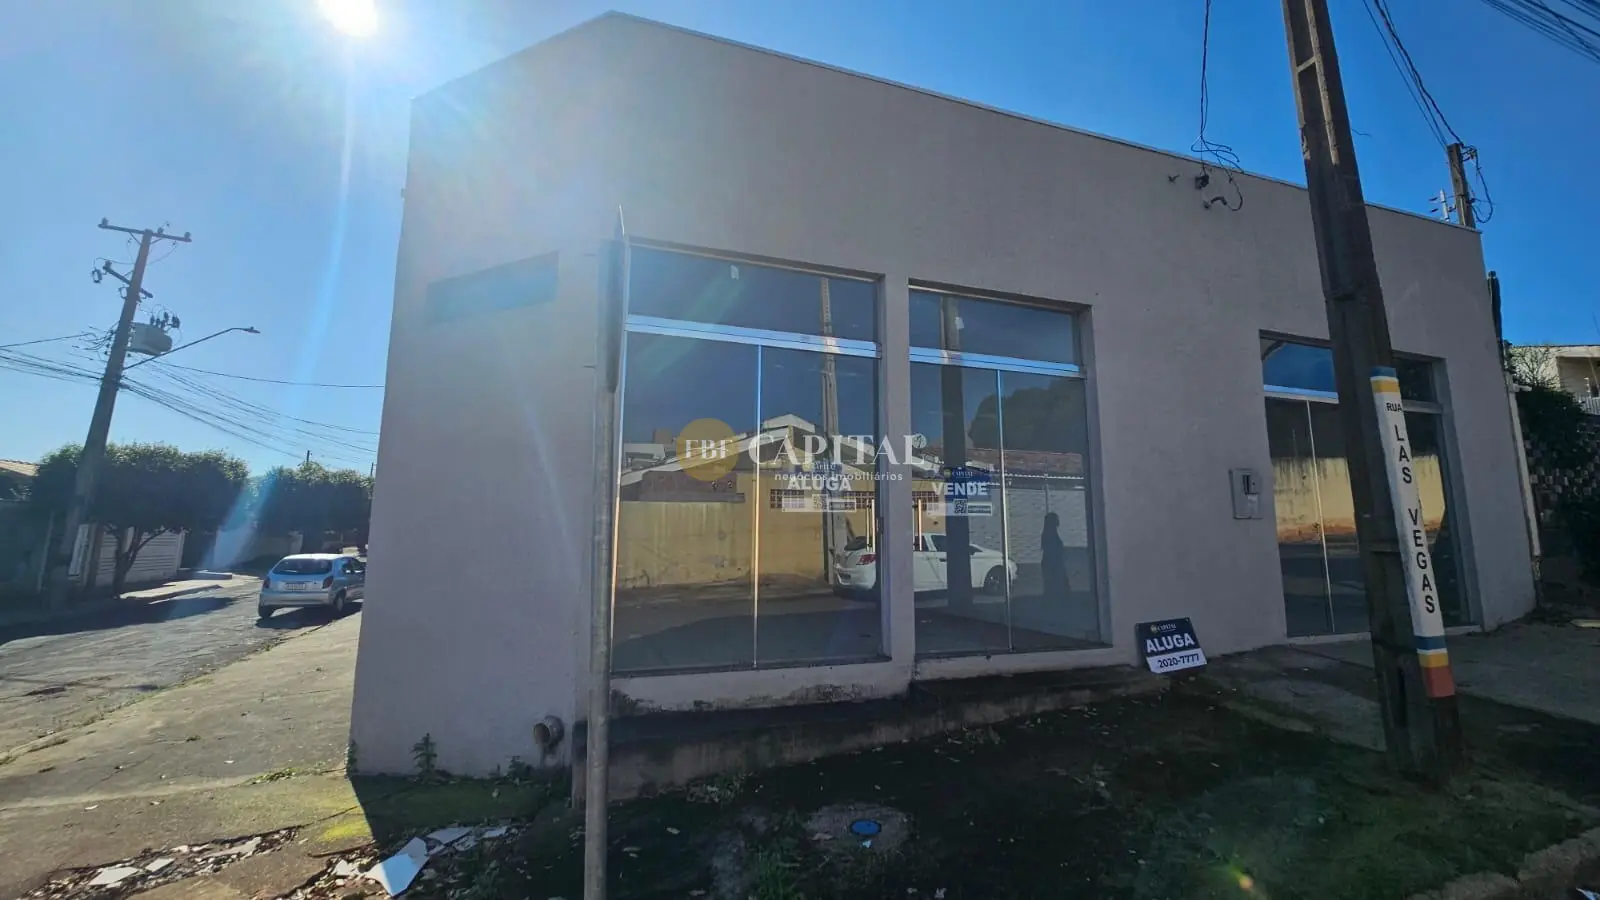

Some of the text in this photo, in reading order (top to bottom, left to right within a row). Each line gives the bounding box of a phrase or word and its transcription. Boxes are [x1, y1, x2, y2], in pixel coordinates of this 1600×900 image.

[787, 477, 852, 491] ALUGA
[931, 482, 988, 496] VENDE
[1385, 402, 1435, 613] RUA LAS VEGAS
[1146, 632, 1195, 653] ALUGA
[1157, 653, 1200, 669] 2020-7777
